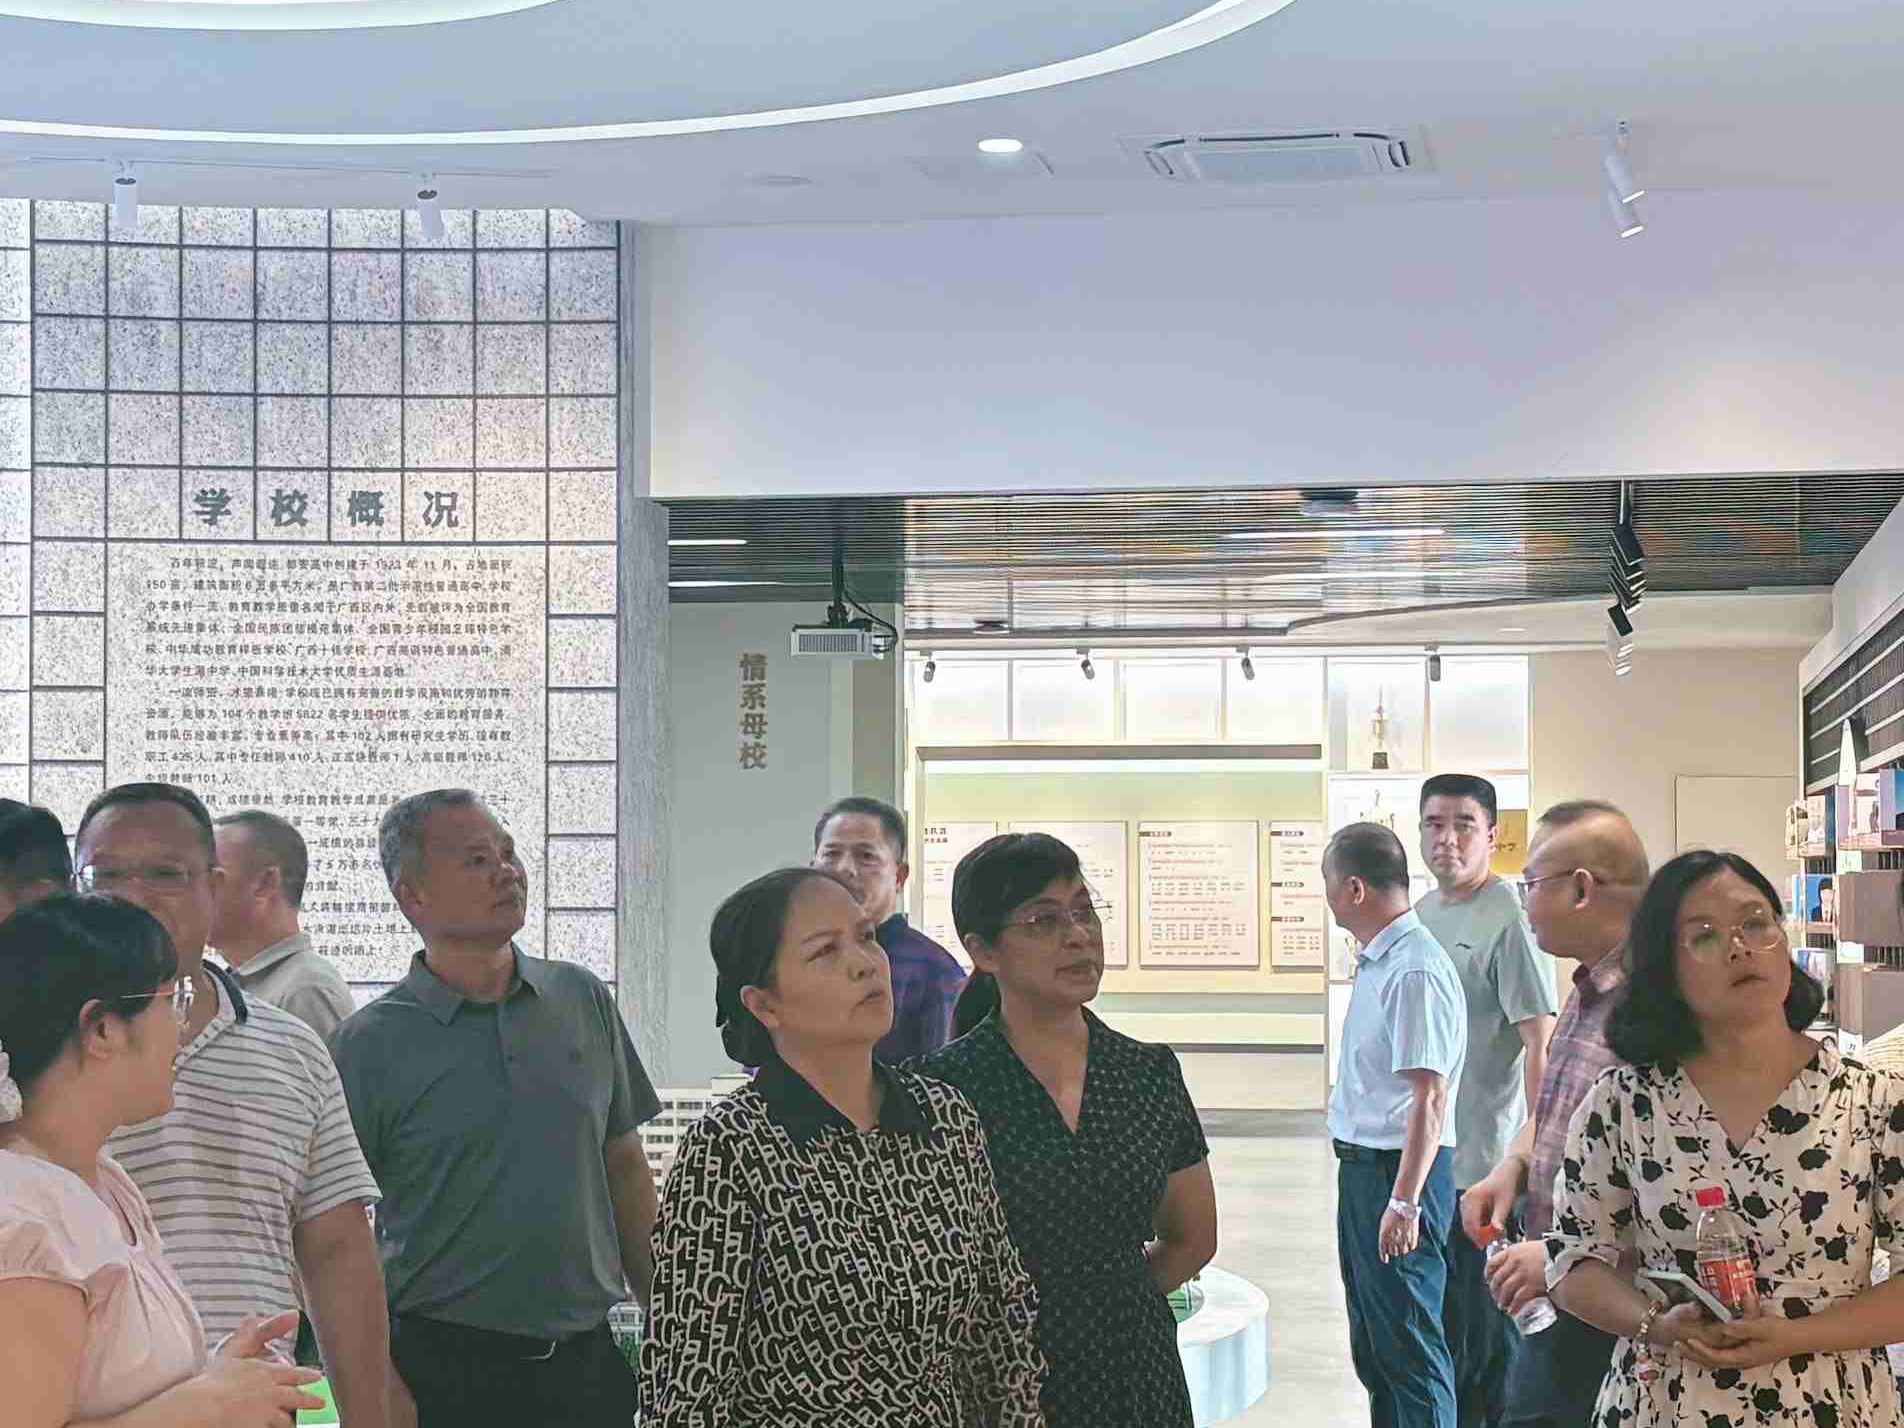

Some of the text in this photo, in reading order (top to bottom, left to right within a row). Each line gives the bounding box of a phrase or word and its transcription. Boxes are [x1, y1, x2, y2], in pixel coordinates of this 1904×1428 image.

[193, 488, 459, 528] 学校概况
[739, 653, 768, 770] 情系母校
